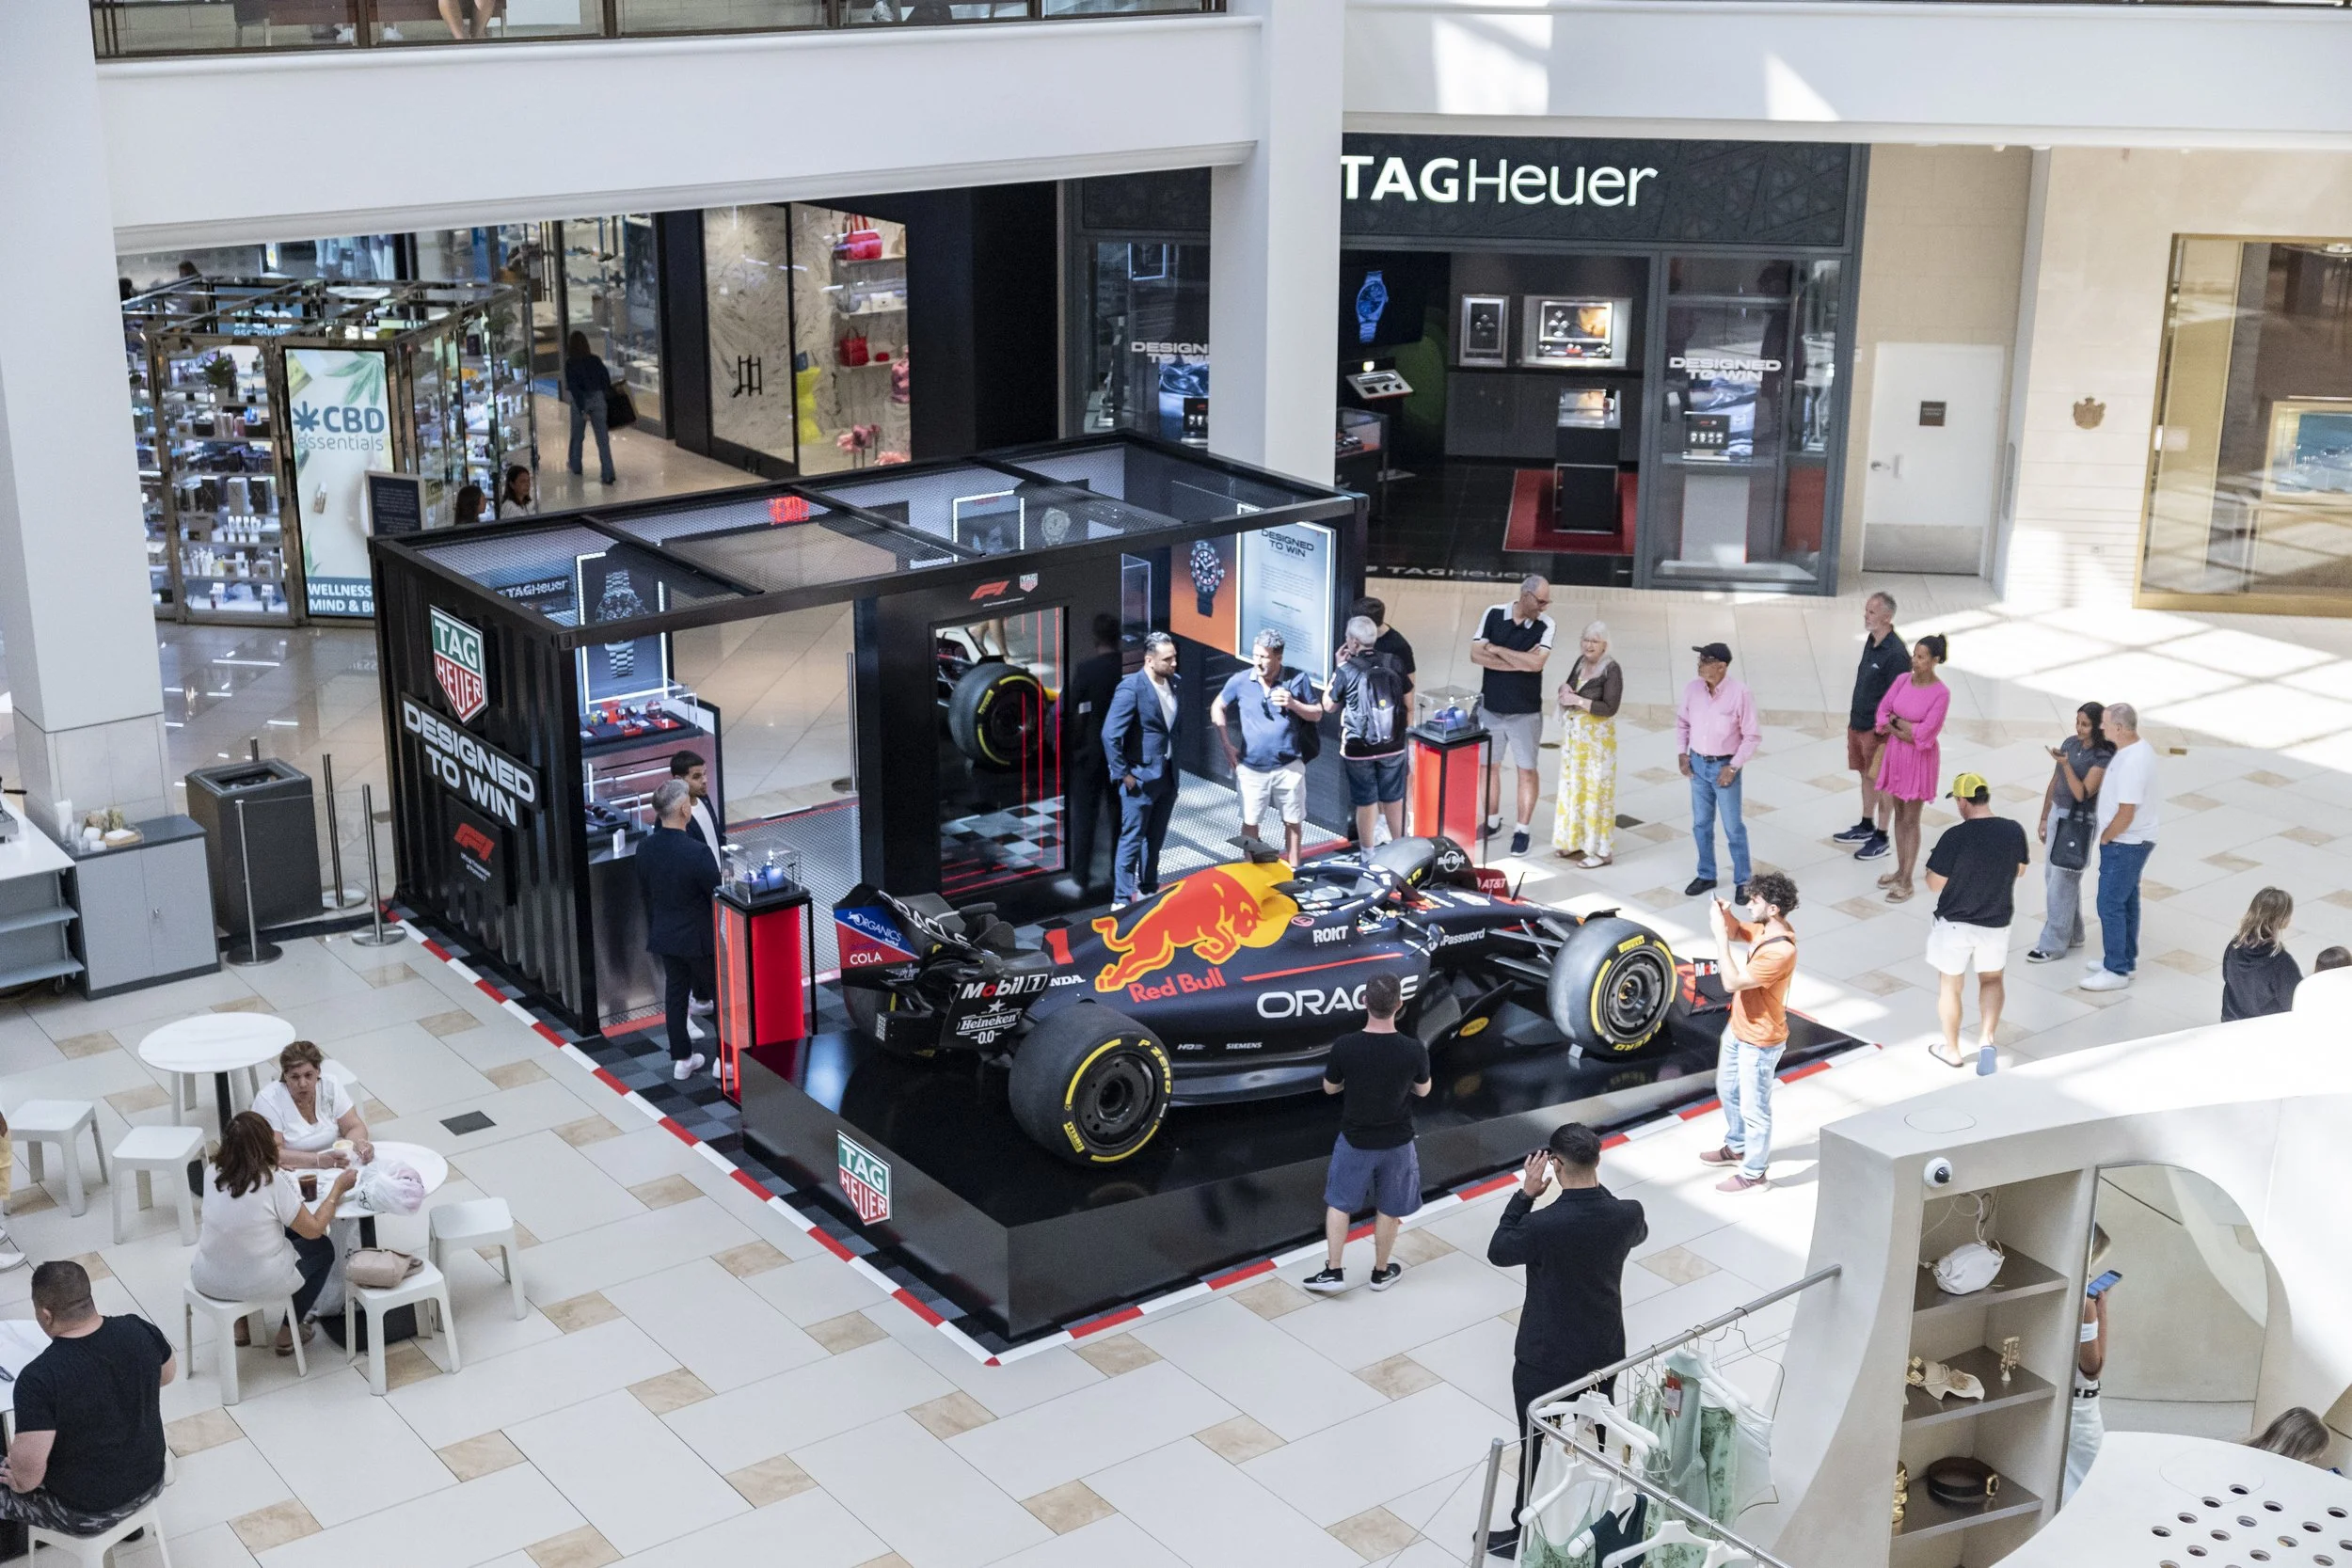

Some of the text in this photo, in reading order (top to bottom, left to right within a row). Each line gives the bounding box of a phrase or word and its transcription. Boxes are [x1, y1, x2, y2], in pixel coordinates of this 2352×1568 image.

[1340, 155, 1658, 207] TAGHeuer
[1131, 341, 1210, 354] DESIGN
[1669, 356, 1782, 372] DESIGNED
[323, 405, 385, 434] CBD
[297, 436, 384, 451] essentials
[1261, 528, 1314, 552] DESIGNED
[1270, 539, 1284, 550] TO
[1285, 545, 1306, 558] WIN
[307, 583, 373, 597] WELLNESS
[309, 599, 374, 612] MIND & B
[435, 618, 478, 669] TAG
[436, 657, 482, 714] HEUER
[403, 701, 535, 803] DESIGNED
[425, 745, 516, 827] TO WIN
[853, 913, 902, 942] ORGANICS
[1312, 925, 1349, 943] ROKT
[850, 952, 882, 965] COLA
[961, 975, 1025, 1000] Mobil
[1049, 974, 1086, 987] NDA
[1128, 967, 1227, 1004] Red Bull
[961, 1014, 1017, 1031] Heineken
[842, 1142, 883, 1192] TAG
[841, 1171, 885, 1220] HEUER
